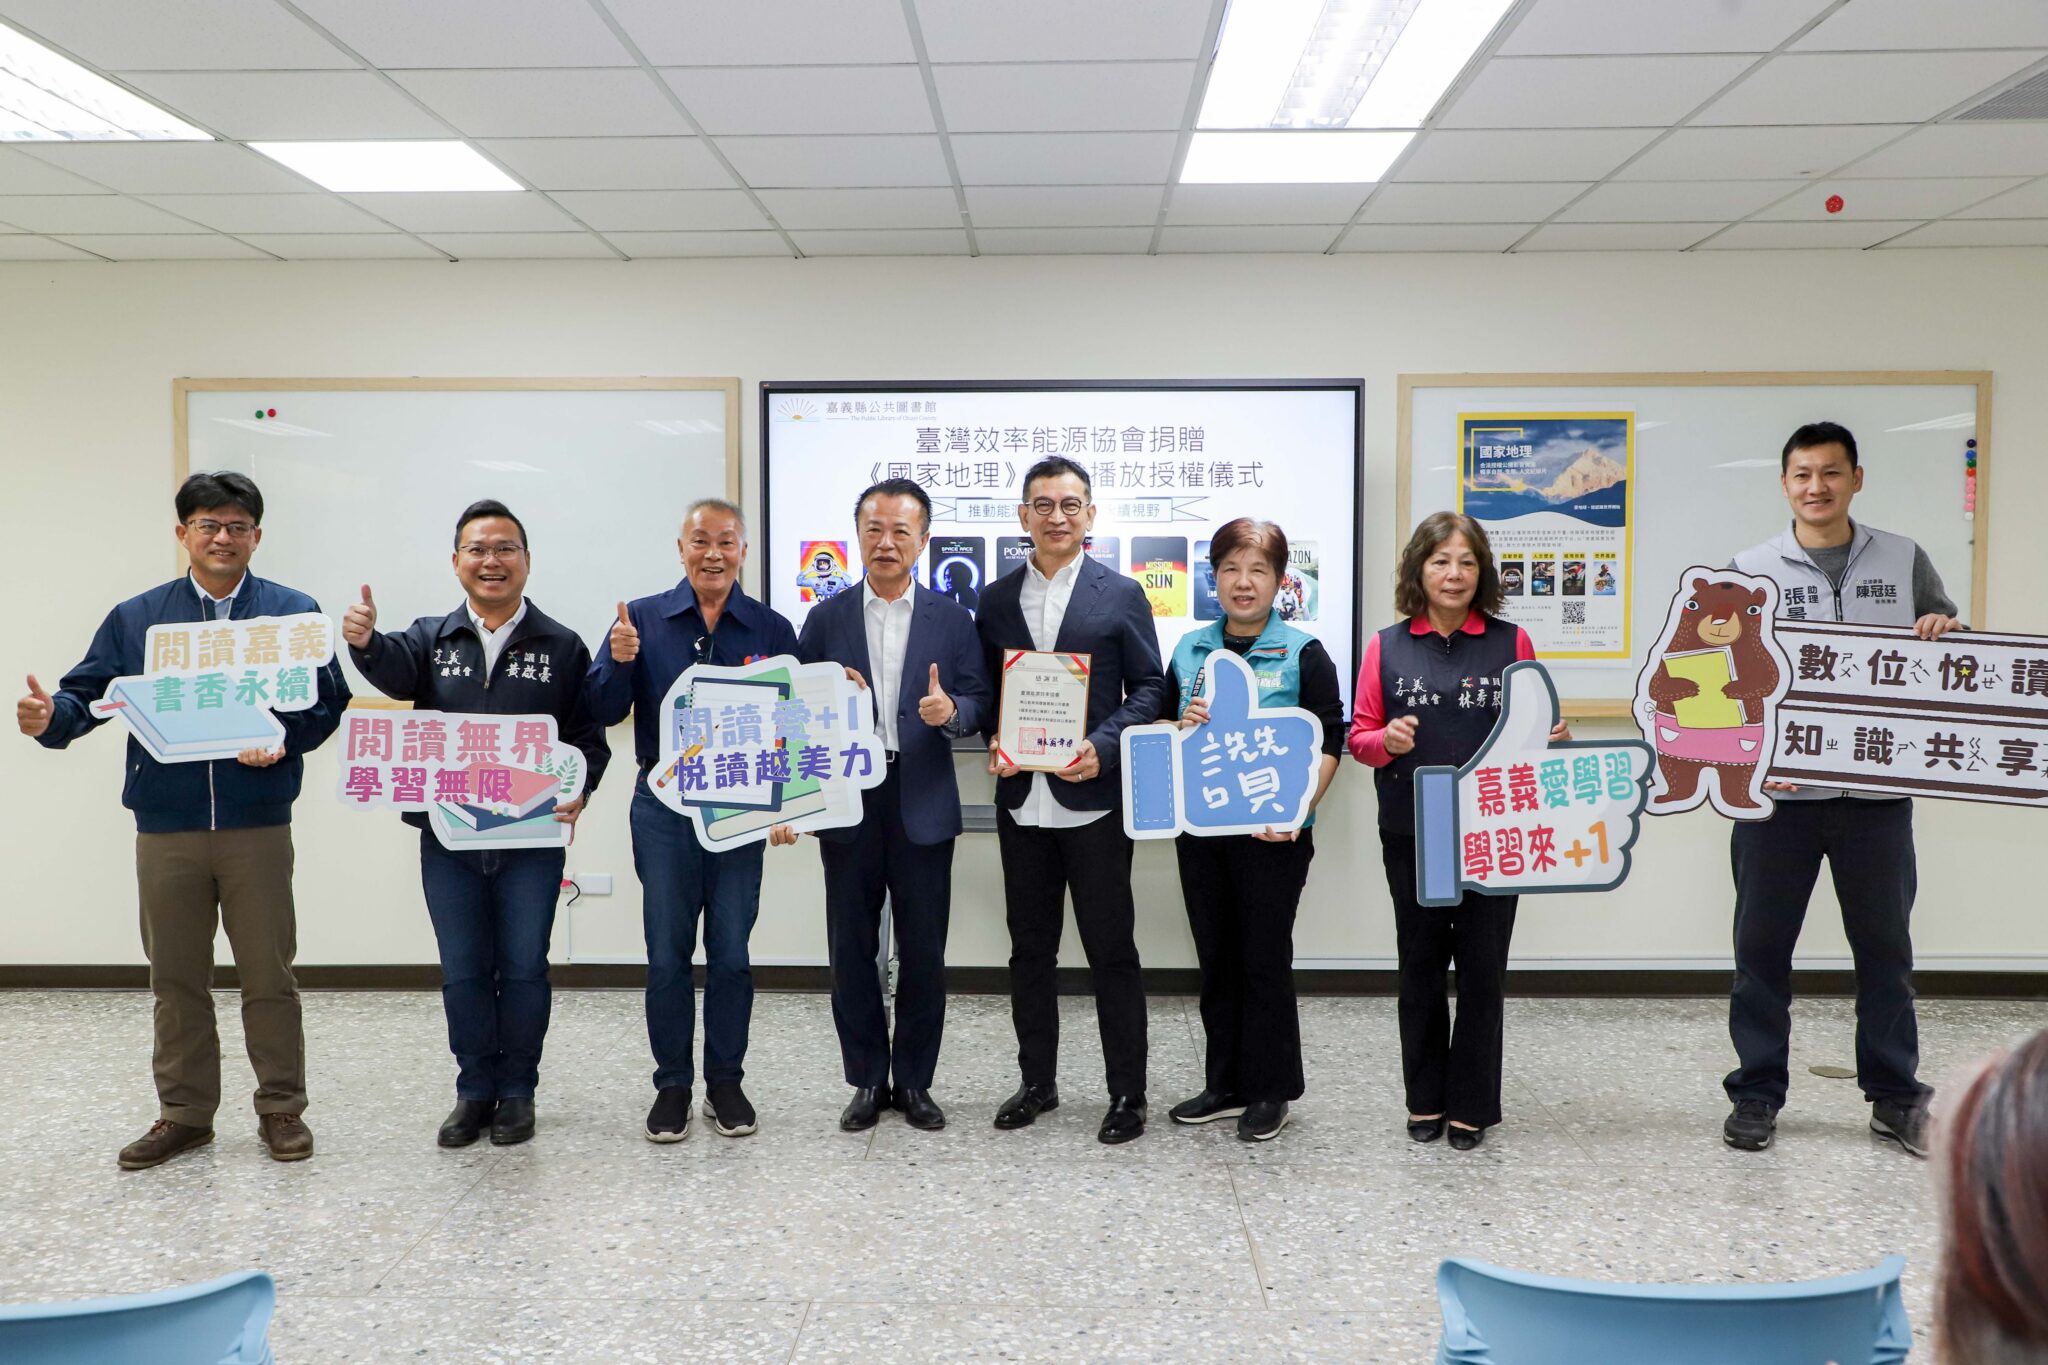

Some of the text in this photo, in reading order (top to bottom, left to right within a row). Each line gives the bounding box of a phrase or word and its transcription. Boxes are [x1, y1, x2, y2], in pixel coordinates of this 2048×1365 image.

[826, 401, 937, 414] 嘉義縣公共圖書館
[915, 425, 1206, 454] 臺灣效率能源協會捐贈
[1479, 446, 1533, 459] 國家地理
[1003, 547, 1036, 556] POMP
[1286, 551, 1311, 563] AZON
[1145, 561, 1174, 570] MISSION
[1145, 574, 1174, 589] SUN
[1807, 585, 1819, 604] 助理
[1856, 585, 1897, 598] 陳冠廷
[152, 621, 327, 673] 閱讀嘉義
[152, 666, 312, 713] 書香永續
[346, 717, 554, 765] 閱讀無界
[1201, 725, 1290, 815] 讚
[346, 766, 514, 803] 學習無限
[1474, 751, 1634, 817] 嘉義愛學習
